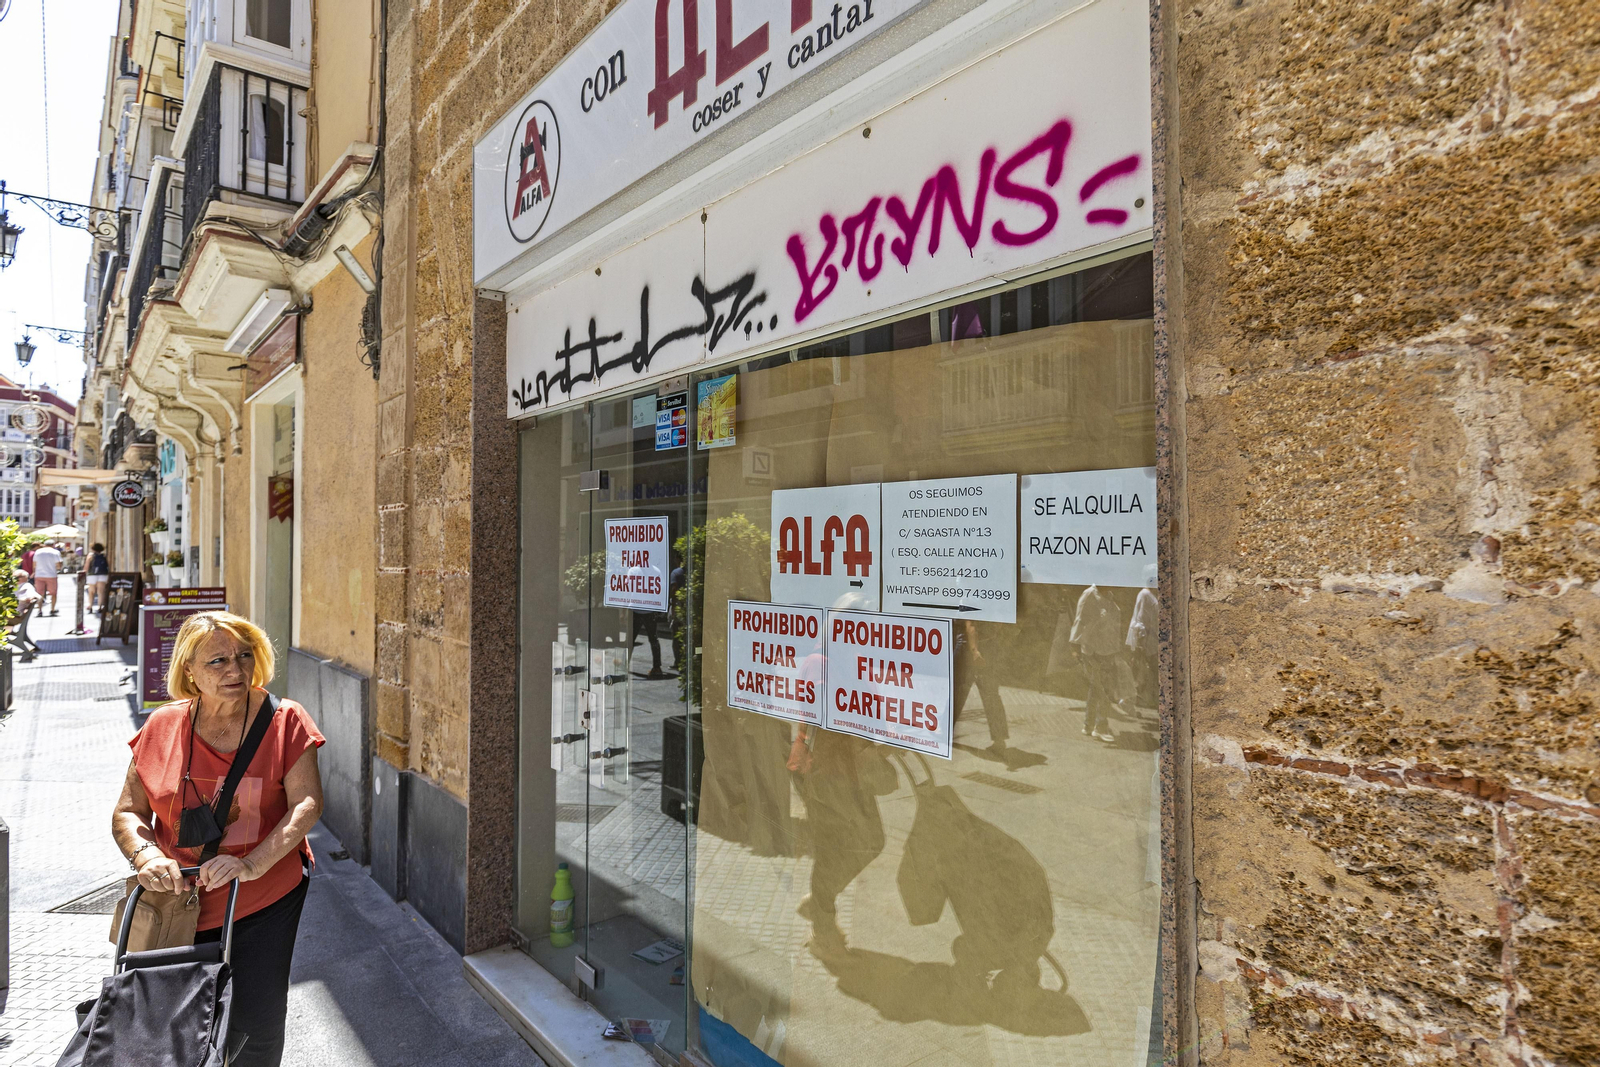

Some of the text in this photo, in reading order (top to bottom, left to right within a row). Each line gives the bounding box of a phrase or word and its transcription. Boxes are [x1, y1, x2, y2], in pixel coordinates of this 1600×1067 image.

[692, 0, 875, 133] coser y cantar
[580, 49, 628, 114] con
[520, 185, 542, 215] ALFA
[657, 413, 671, 423] VISA
[657, 432, 671, 443] VISA
[909, 486, 983, 500] OS SEGUIMOS
[901, 507, 988, 519] ATENDIENDO EN
[1034, 493, 1143, 516] SE ALQUILA
[609, 523, 664, 543] PROHIBIDO
[899, 528, 911, 538] C/
[914, 528, 960, 537] SAGASTA
[898, 548, 921, 558] ESQ.
[924, 548, 955, 557] CALLE
[957, 548, 998, 558] ANCHA
[1030, 536, 1147, 555] RAZON ALFA
[621, 550, 650, 568] FIJAR
[900, 567, 988, 579] TLF: 956214210
[610, 574, 662, 595] CARTELES
[886, 585, 1011, 601] WHATSAPP 699743999
[734, 609, 819, 639] PROHIBIDO
[832, 619, 943, 656] PROHIBIDO
[752, 641, 797, 669] FIJAR
[857, 656, 914, 689] FIJAR
[736, 669, 816, 704] CARTELES
[835, 687, 938, 732] CARTELES
[875, 728, 899, 739] EMPRESA
